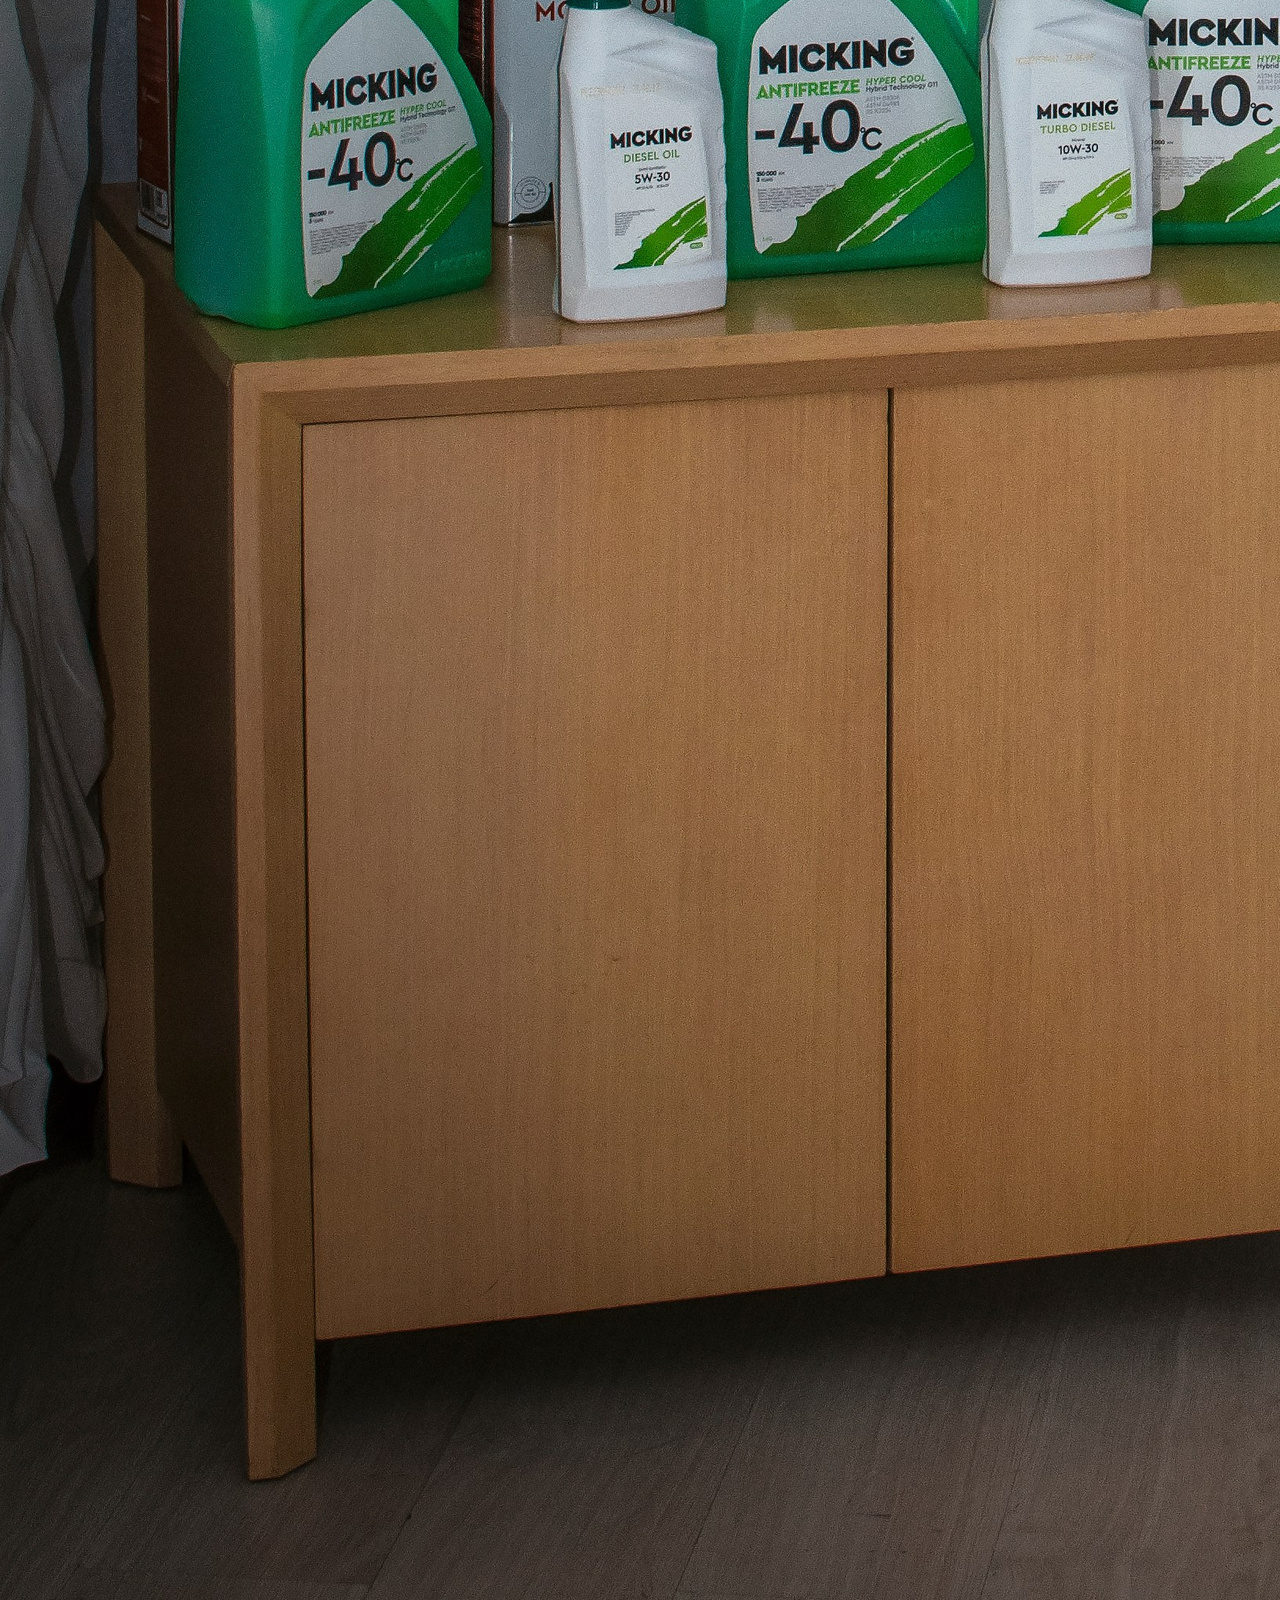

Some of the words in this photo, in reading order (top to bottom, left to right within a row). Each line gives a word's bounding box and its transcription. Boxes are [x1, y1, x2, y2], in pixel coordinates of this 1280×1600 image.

[759, 37, 915, 75] MICKING
[1148, 55, 1251, 70] ANTIFREEZE
[1257, 63, 1279, 71] Hybrid
[311, 63, 438, 112] MICKING
[866, 76, 896, 87] HYPER
[900, 75, 927, 84] COOL
[866, 84, 889, 93] Hybrid
[890, 81, 926, 91] Technology
[756, 79, 861, 99] ANTIFREEZE
[401, 103, 424, 114] HYPER
[426, 99, 447, 110] COOL
[1037, 100, 1119, 120] MICKING
[309, 110, 396, 138] ANTIFREEZE
[1041, 123, 1078, 134] TURBO
[1081, 121, 1116, 132] DIESEL
[611, 126, 693, 149] MICKING
[624, 150, 660, 163] DIESEL
[662, 149, 680, 160] OIL
[1058, 143, 1099, 155] 10W-30
[635, 171, 671, 184] 5W-30
